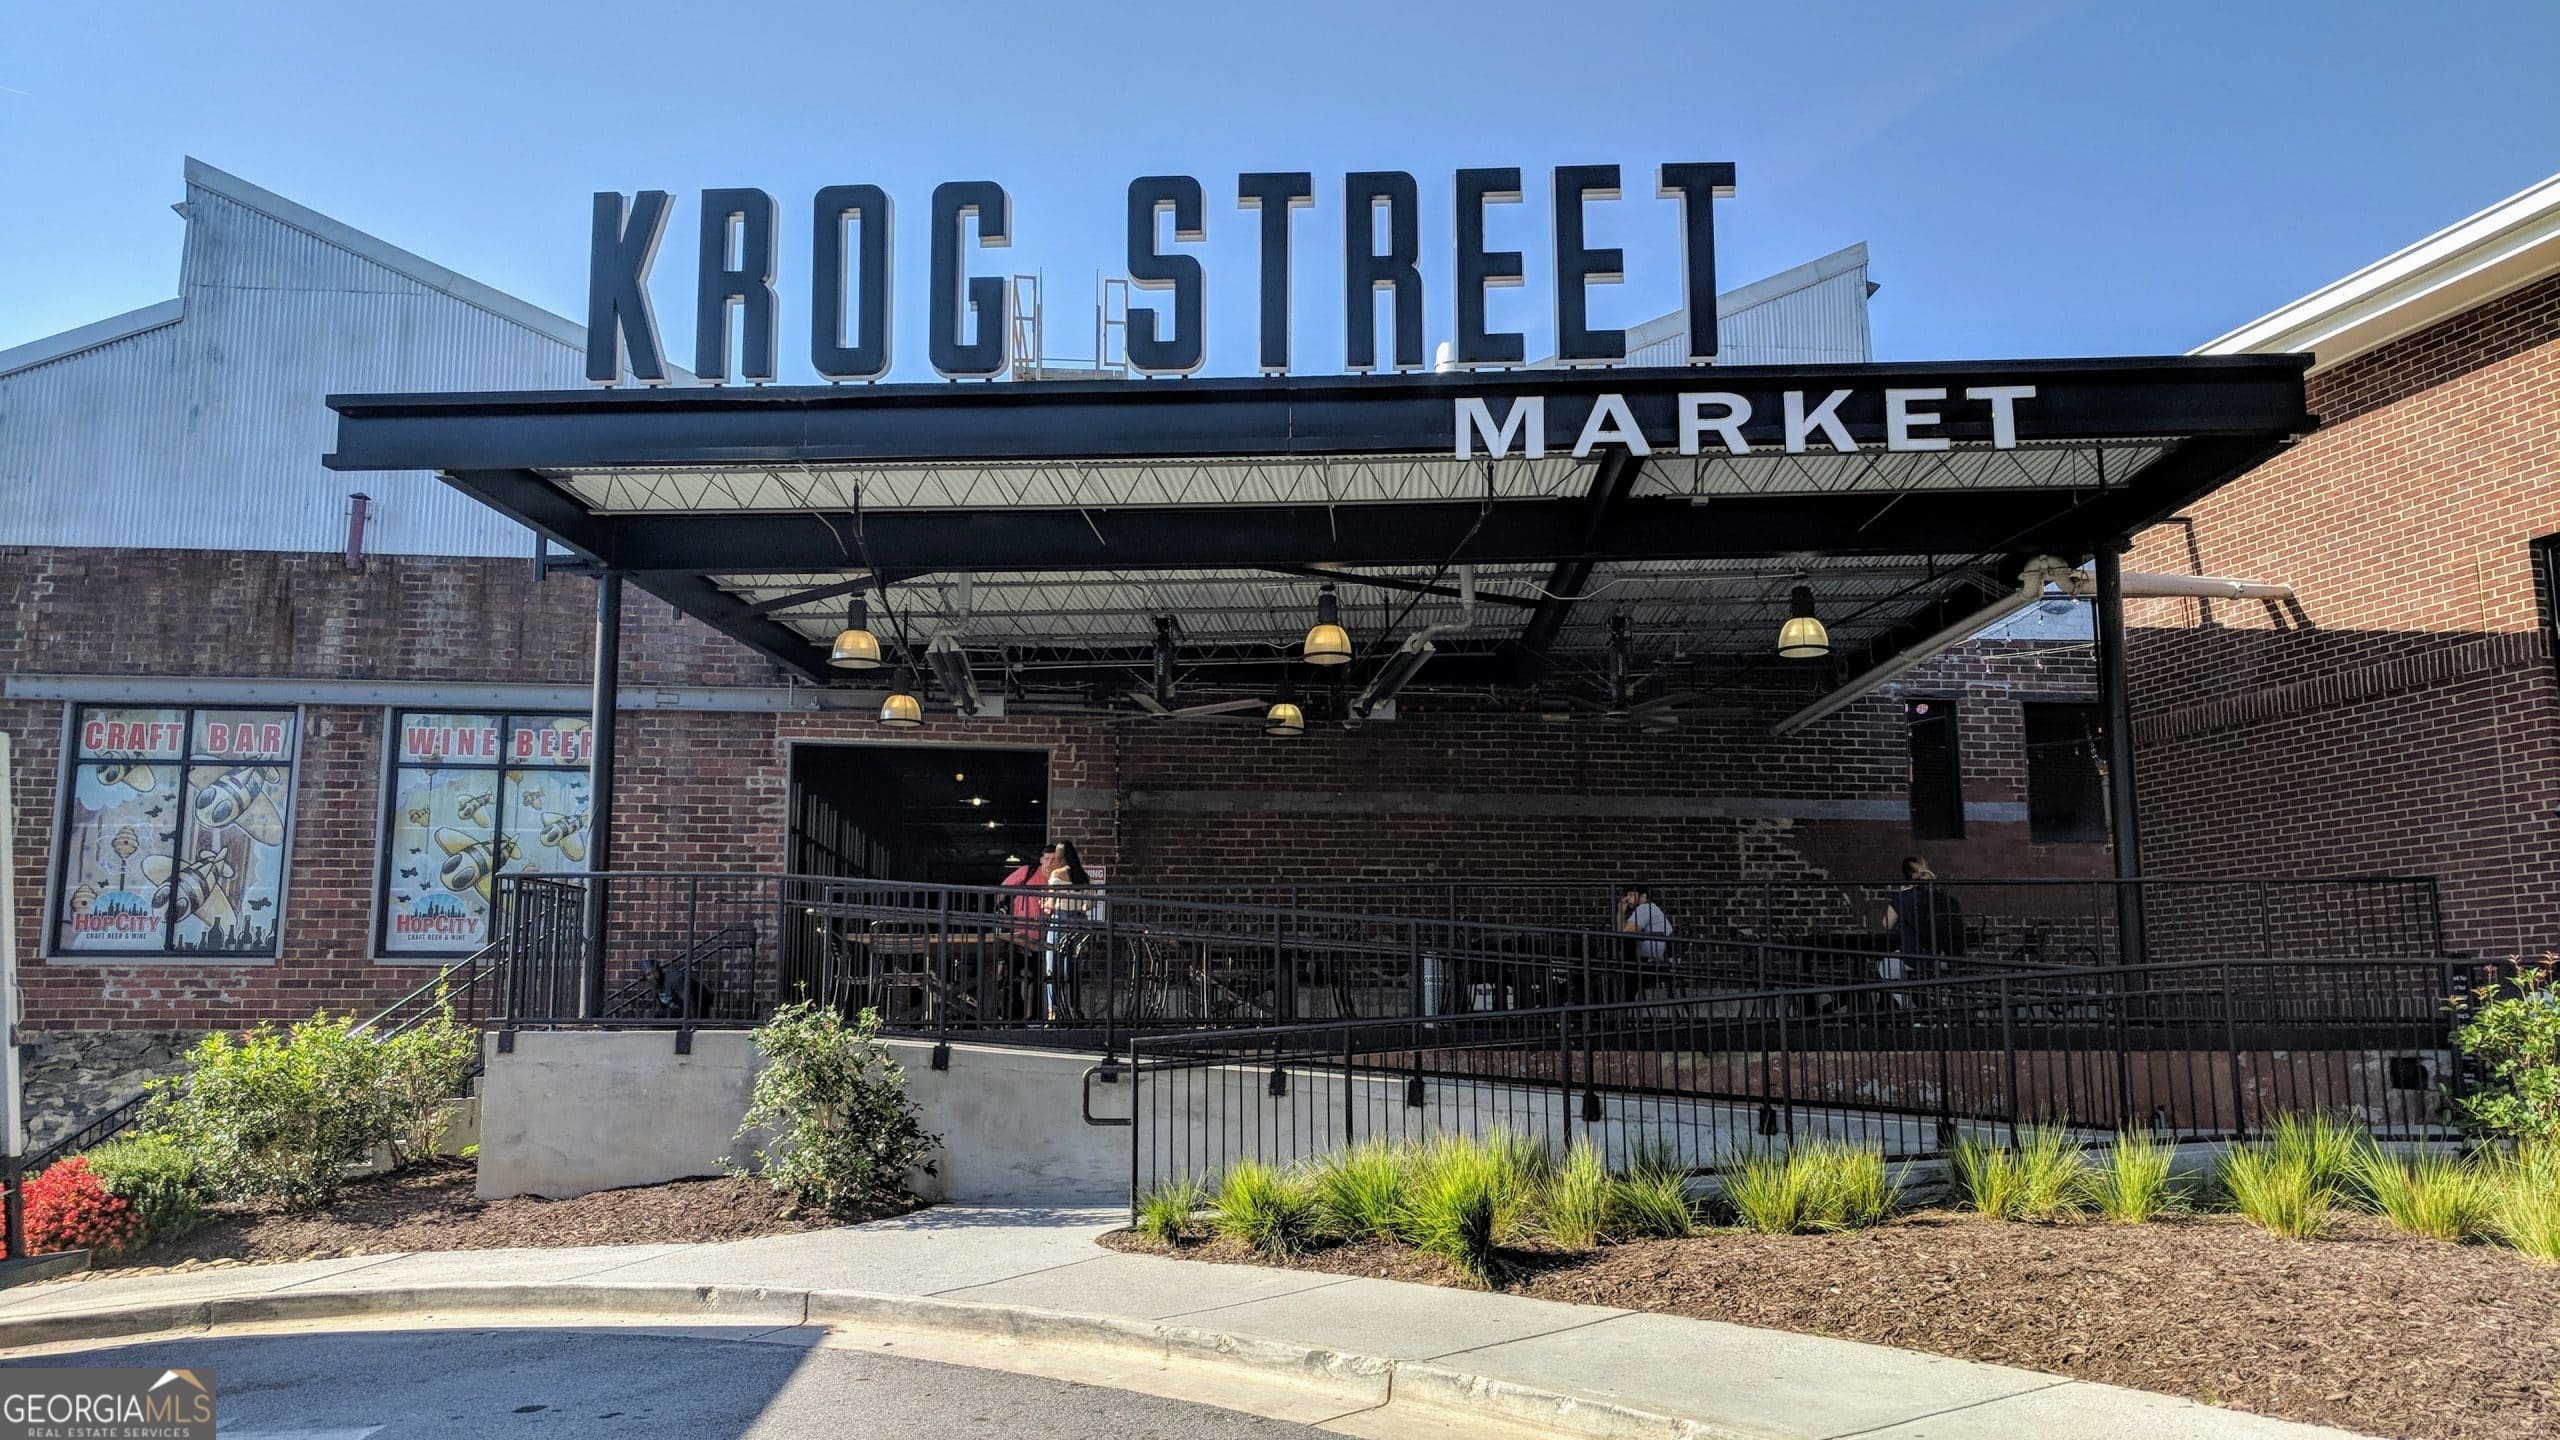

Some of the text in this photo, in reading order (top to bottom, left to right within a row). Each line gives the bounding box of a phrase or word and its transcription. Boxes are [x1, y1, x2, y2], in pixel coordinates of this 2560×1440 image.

[586, 162, 1737, 384] KROG STREET
[1454, 384, 2037, 461] MARKET
[84, 721, 283, 754] CRAFT BAR
[407, 726, 592, 758] WINE BEER
[86, 932, 105, 940] CRAFT
[107, 932, 123, 940] BEER
